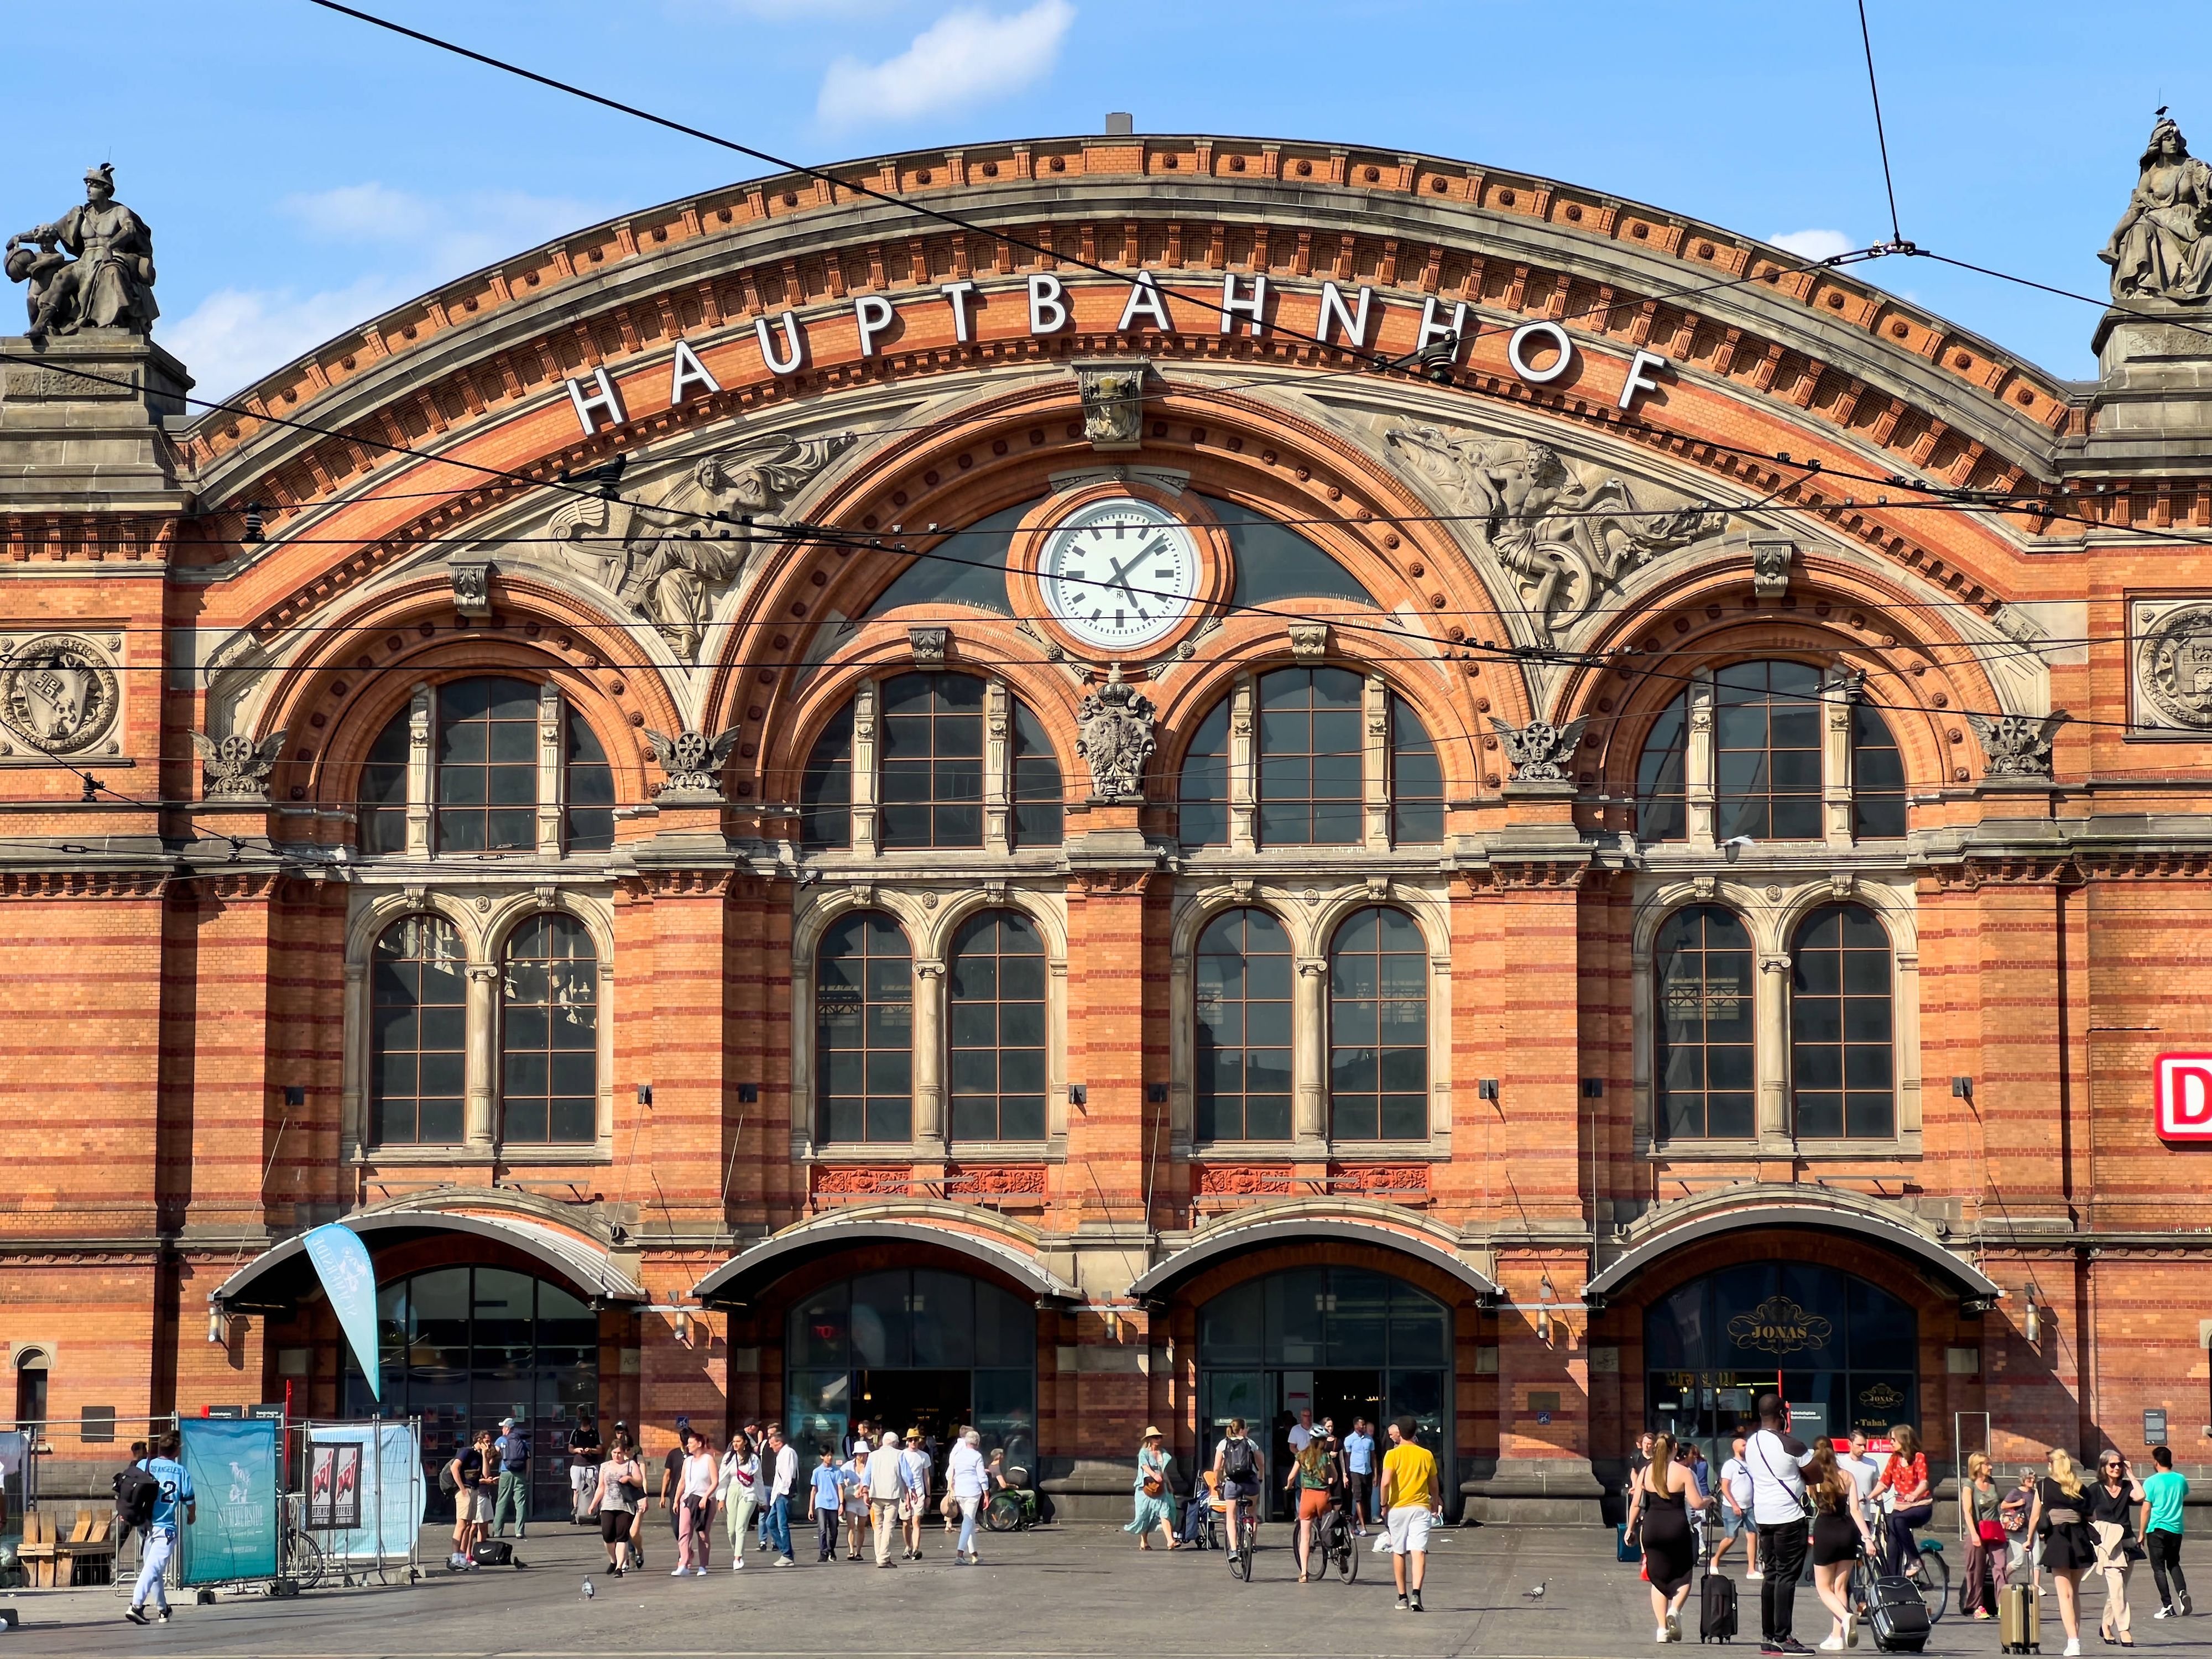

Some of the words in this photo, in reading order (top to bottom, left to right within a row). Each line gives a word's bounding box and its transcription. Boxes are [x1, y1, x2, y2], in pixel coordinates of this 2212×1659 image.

[567, 270, 1667, 436] HAUPTBAHNHOF
[1751, 1326, 1807, 1339] JONAS
[335, 1506, 353, 1516] BREMEN
